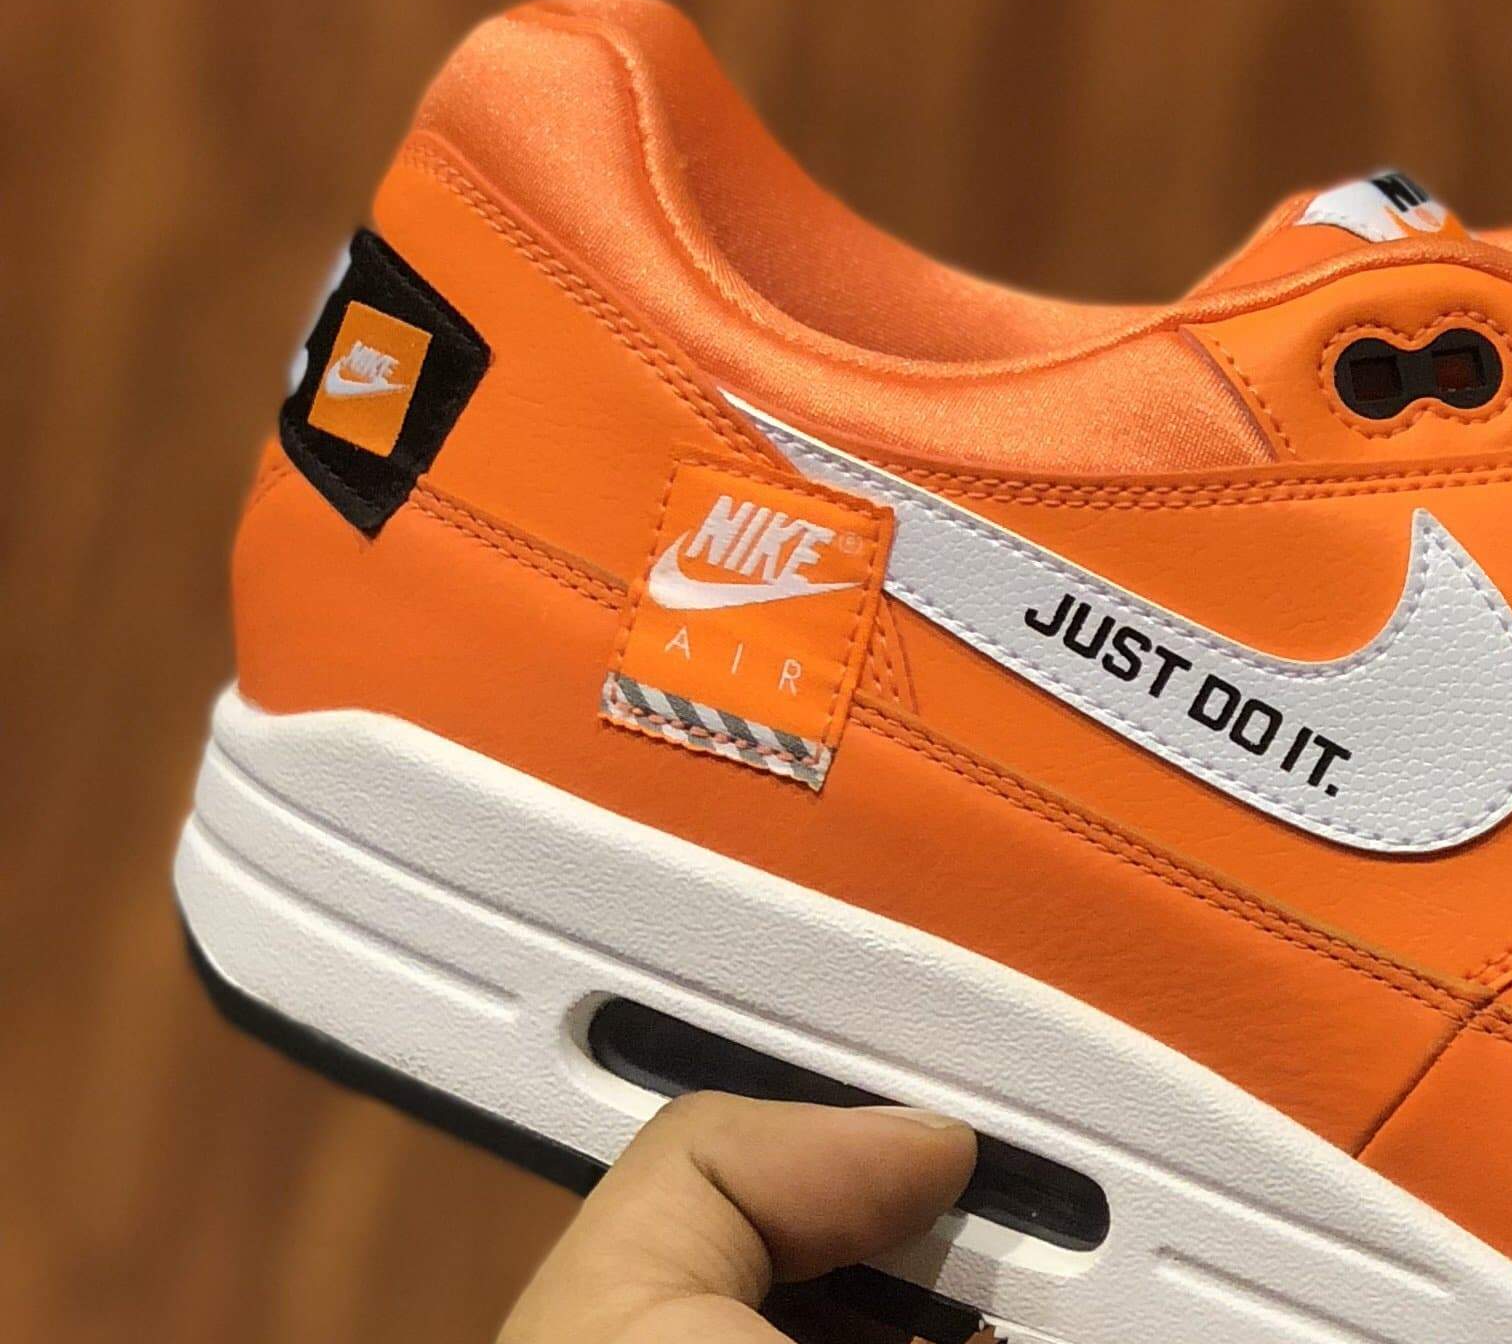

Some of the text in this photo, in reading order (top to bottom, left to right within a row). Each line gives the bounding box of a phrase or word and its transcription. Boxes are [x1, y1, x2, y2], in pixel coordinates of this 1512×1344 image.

[686, 495, 836, 587] NIKE
[664, 625, 803, 697] AIR
[1024, 593, 1351, 797] JUST DO IT.
